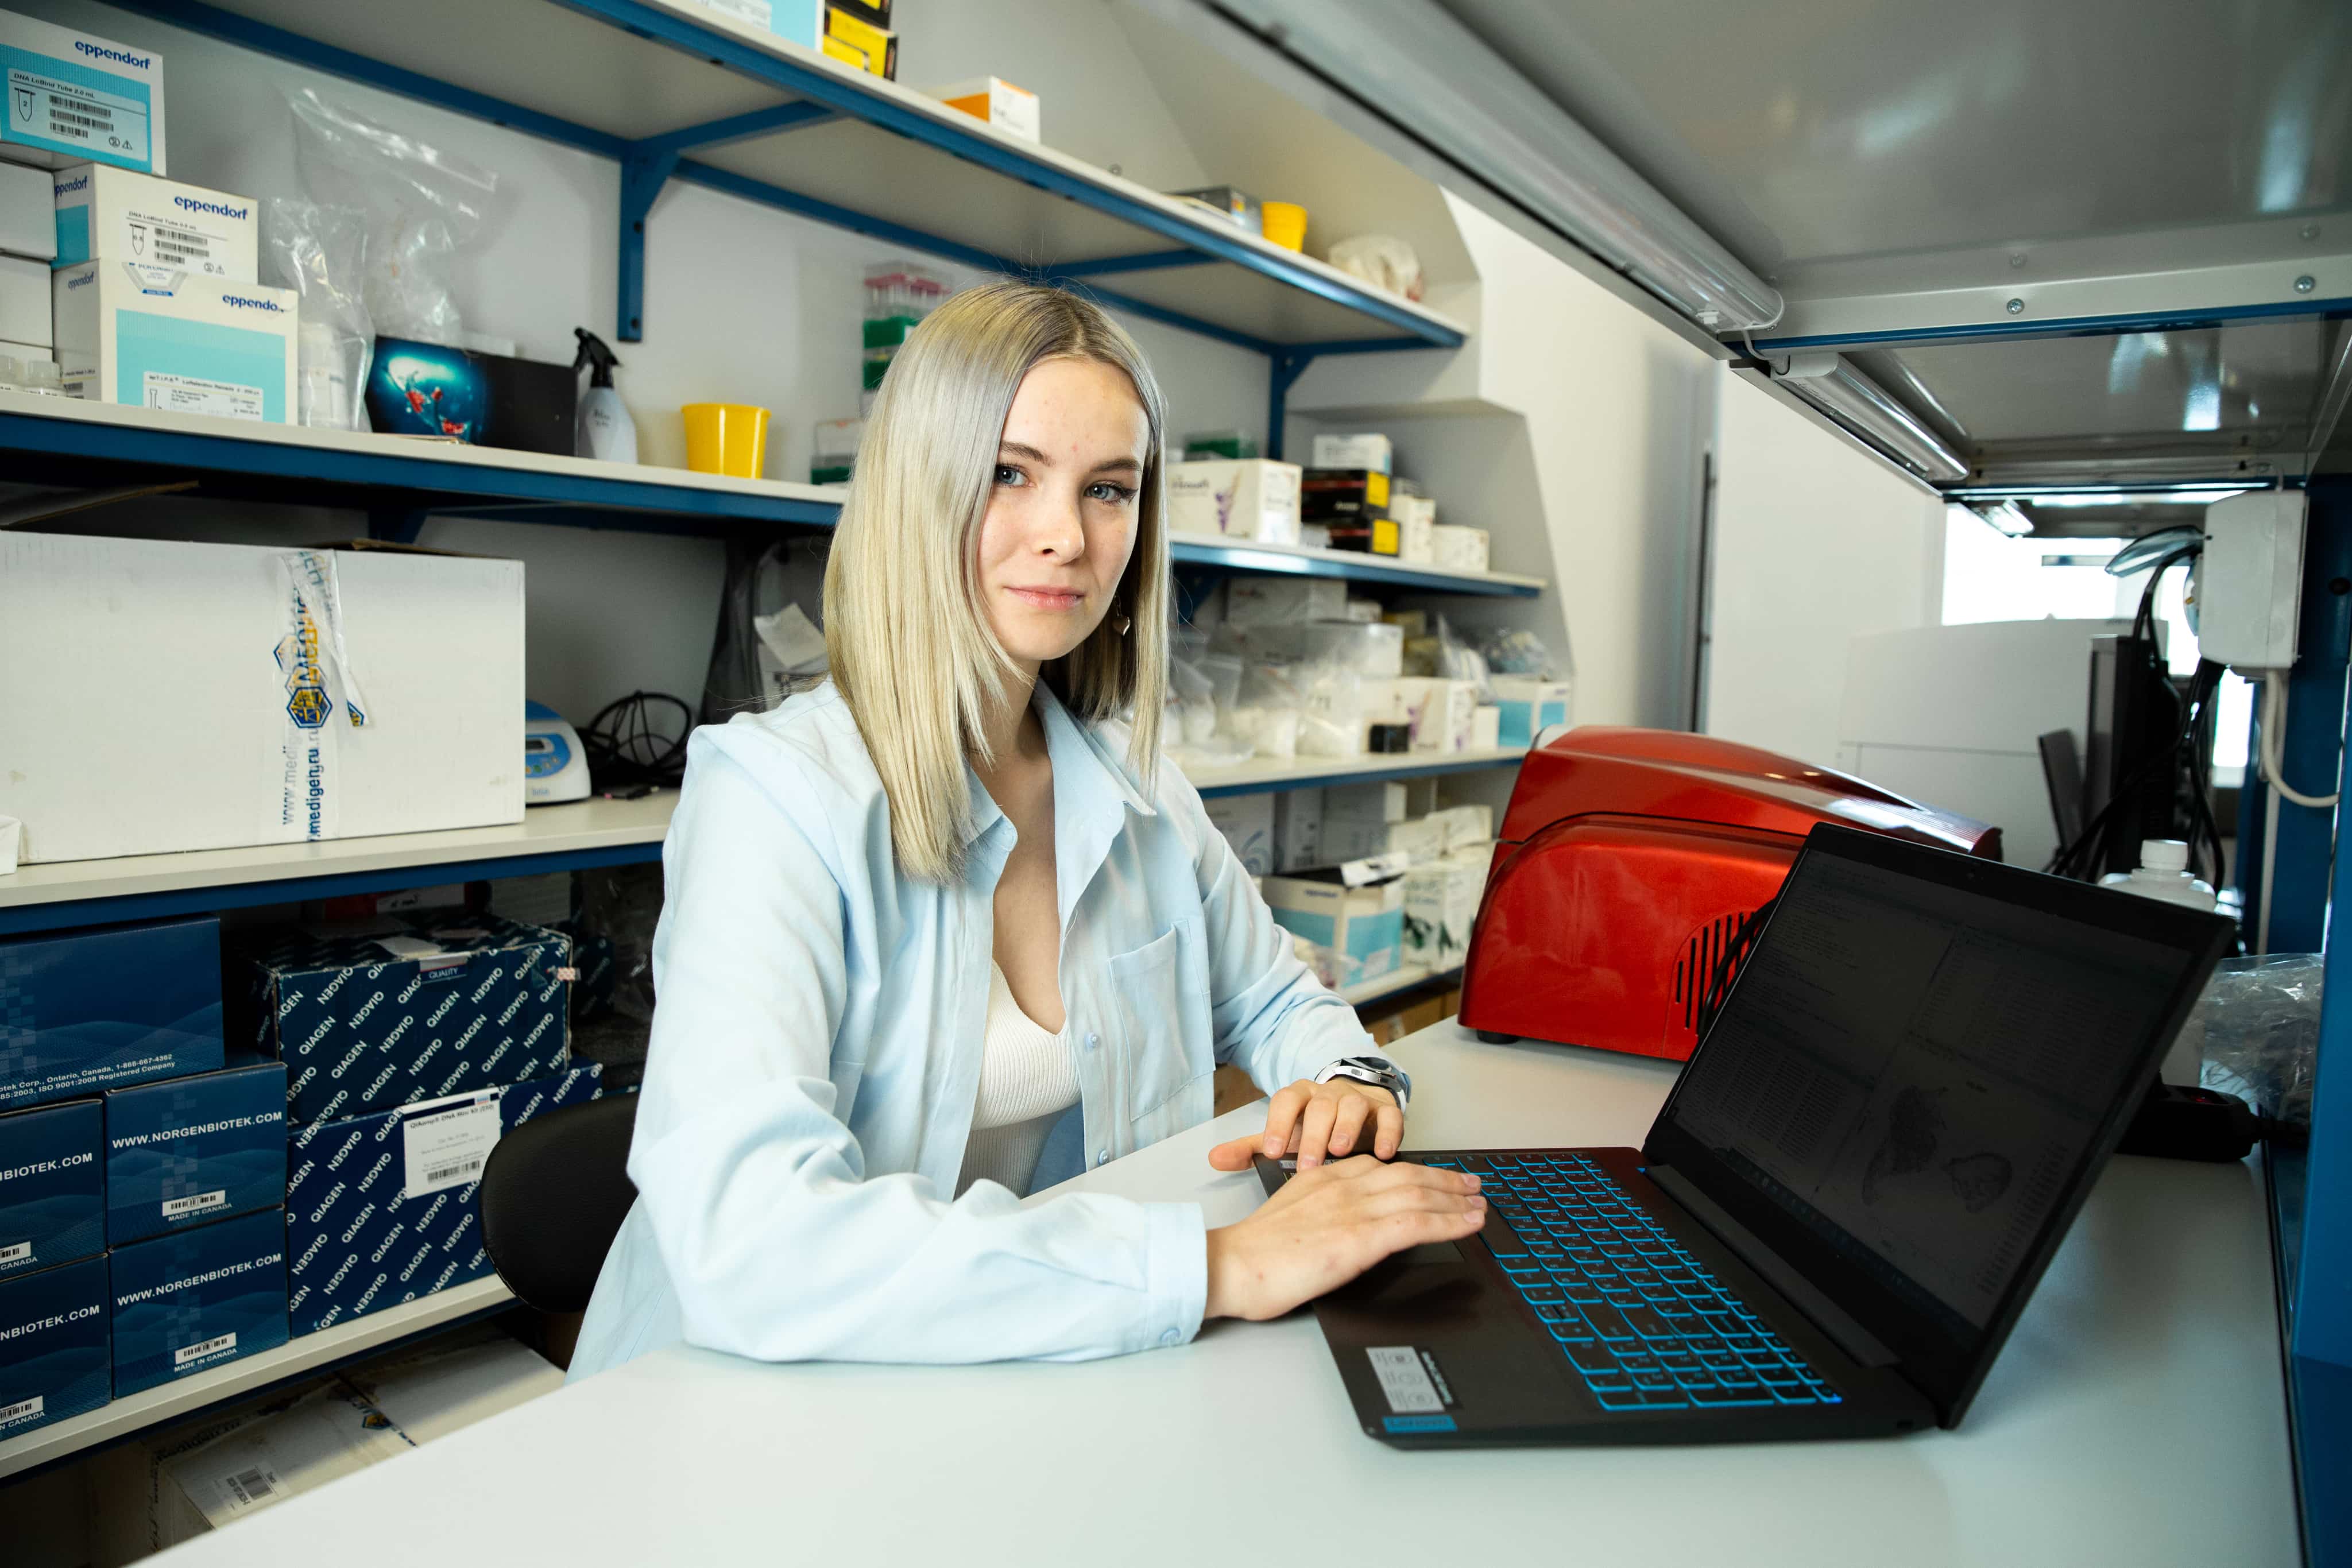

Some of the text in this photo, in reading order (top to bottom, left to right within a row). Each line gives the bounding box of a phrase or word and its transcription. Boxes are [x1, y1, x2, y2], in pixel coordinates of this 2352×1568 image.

[75, 40, 150, 69] eppendorf
[14, 73, 29, 82] DNA
[56, 83, 72, 92] Tube
[55, 176, 88, 196] ppendorf
[174, 196, 248, 220] eppendorf
[222, 293, 285, 313] eppendo
[316, 967, 354, 1005] QIAGEN
[471, 967, 503, 1004] QIAGEN
[349, 991, 384, 1029] QIAGEN
[427, 990, 460, 1028] QIAGEN
[497, 990, 529, 1027] QIAGEN
[299, 1016, 336, 1055] QIAGEN
[379, 1015, 414, 1053] QIAGEN
[454, 1014, 488, 1051] QIAGEN
[523, 1013, 554, 1048] QIAGEN
[331, 1040, 368, 1079] QIAGEN
[408, 1038, 443, 1076] QIAGEN
[481, 1036, 513, 1073] QIAGEN
[548, 1046, 566, 1070] GEN
[19, 1079, 44, 1089] Corp.,
[47, 1073, 79, 1083] Ontario,
[82, 1066, 114, 1077] Canada,
[38, 1085, 53, 1093] ISO
[99, 1068, 140, 1081] Registered
[142, 1062, 175, 1073] Company
[362, 1063, 397, 1101] QIAGEN
[436, 1061, 470, 1097] QIAGEN
[552, 1068, 581, 1104] QIAGEN
[113, 1112, 282, 1148] WWW.NORGENBIOTEK.COM
[327, 1131, 362, 1171] QIAGEN
[358, 1153, 392, 1193] QIAGEN
[168, 1213, 189, 1222] MADE
[202, 1203, 233, 1213] CANADA
[311, 1181, 346, 1222] QIAGEN
[386, 1187, 407, 1213] GEN
[415, 1194, 447, 1233] QIAGEN
[342, 1202, 376, 1243] QIAGEN
[442, 1213, 474, 1252] QIAGEN
[292, 1234, 328, 1275] QIAGEN
[371, 1222, 405, 1263] QIAGEN
[468, 1248, 487, 1271] GEN
[1, 1256, 38, 1271] CANADA
[118, 1253, 281, 1306] WWW.NORGENBIOTEK.COM
[323, 1254, 358, 1295] QIAGEN
[400, 1242, 432, 1282] QIAGEN
[290, 1284, 311, 1312] GEN
[353, 1273, 388, 1314] QIAGEN
[316, 1304, 342, 1330] GEN
[174, 1361, 195, 1373] MADE
[207, 1348, 237, 1361] CANADA
[8, 1411, 45, 1428] CANADA
